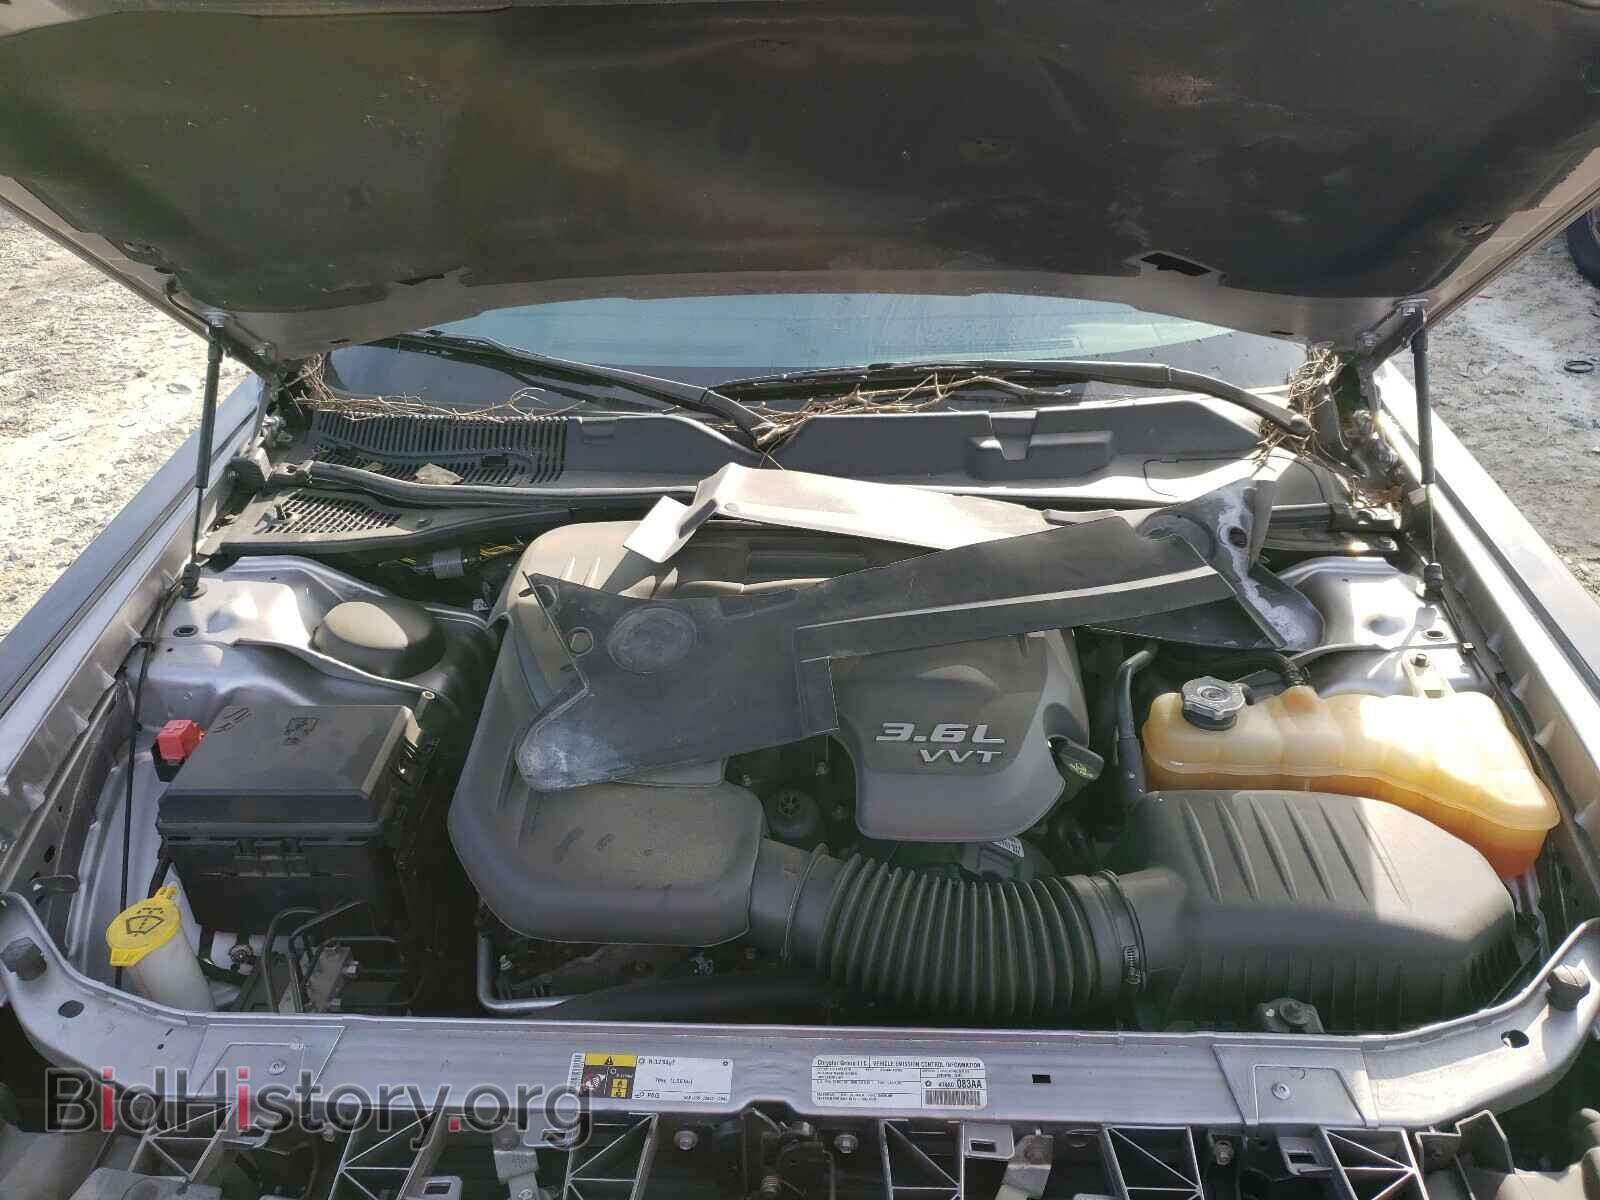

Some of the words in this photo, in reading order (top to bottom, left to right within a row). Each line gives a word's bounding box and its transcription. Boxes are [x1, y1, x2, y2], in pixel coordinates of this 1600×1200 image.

[876, 722, 1005, 744] 3.6L
[919, 749, 1002, 764] VVT
[956, 1079, 983, 1089] 083AA
